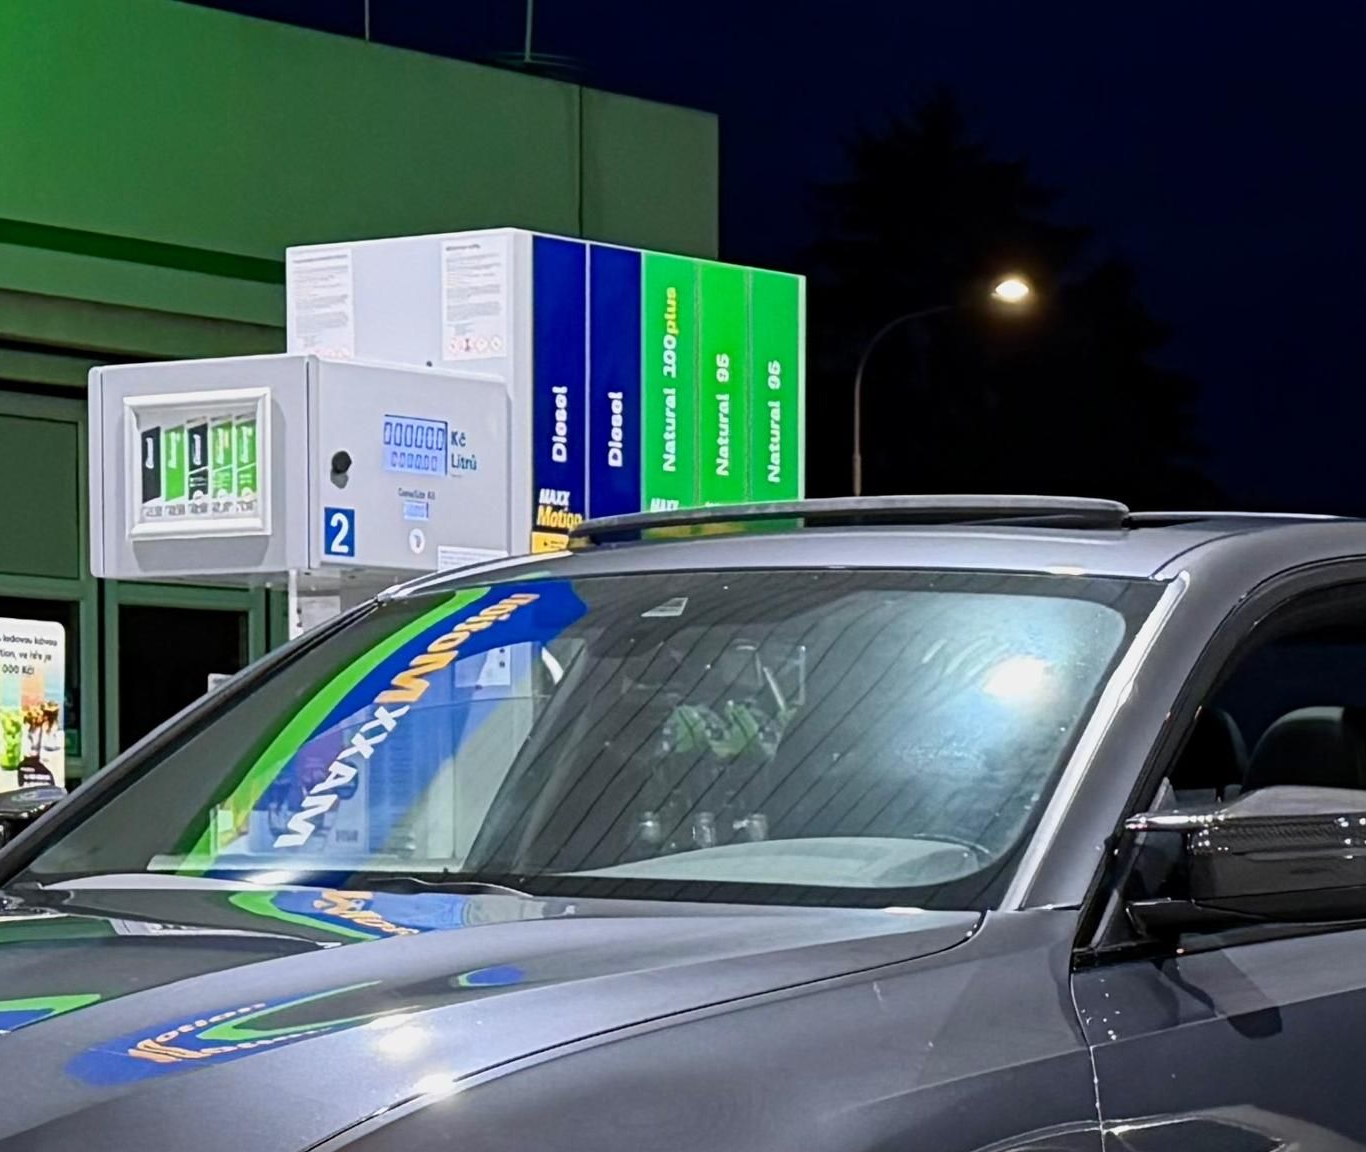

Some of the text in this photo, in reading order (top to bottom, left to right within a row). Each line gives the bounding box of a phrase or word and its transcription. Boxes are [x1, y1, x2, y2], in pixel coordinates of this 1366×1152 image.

[552, 386, 567, 463] Diesel
[608, 391, 623, 467] Diesel
[663, 388, 676, 472] Natural
[716, 394, 729, 476] Natural
[768, 400, 781, 483] Natural
[330, 512, 349, 554] 2
[539, 488, 571, 506] MAXX
